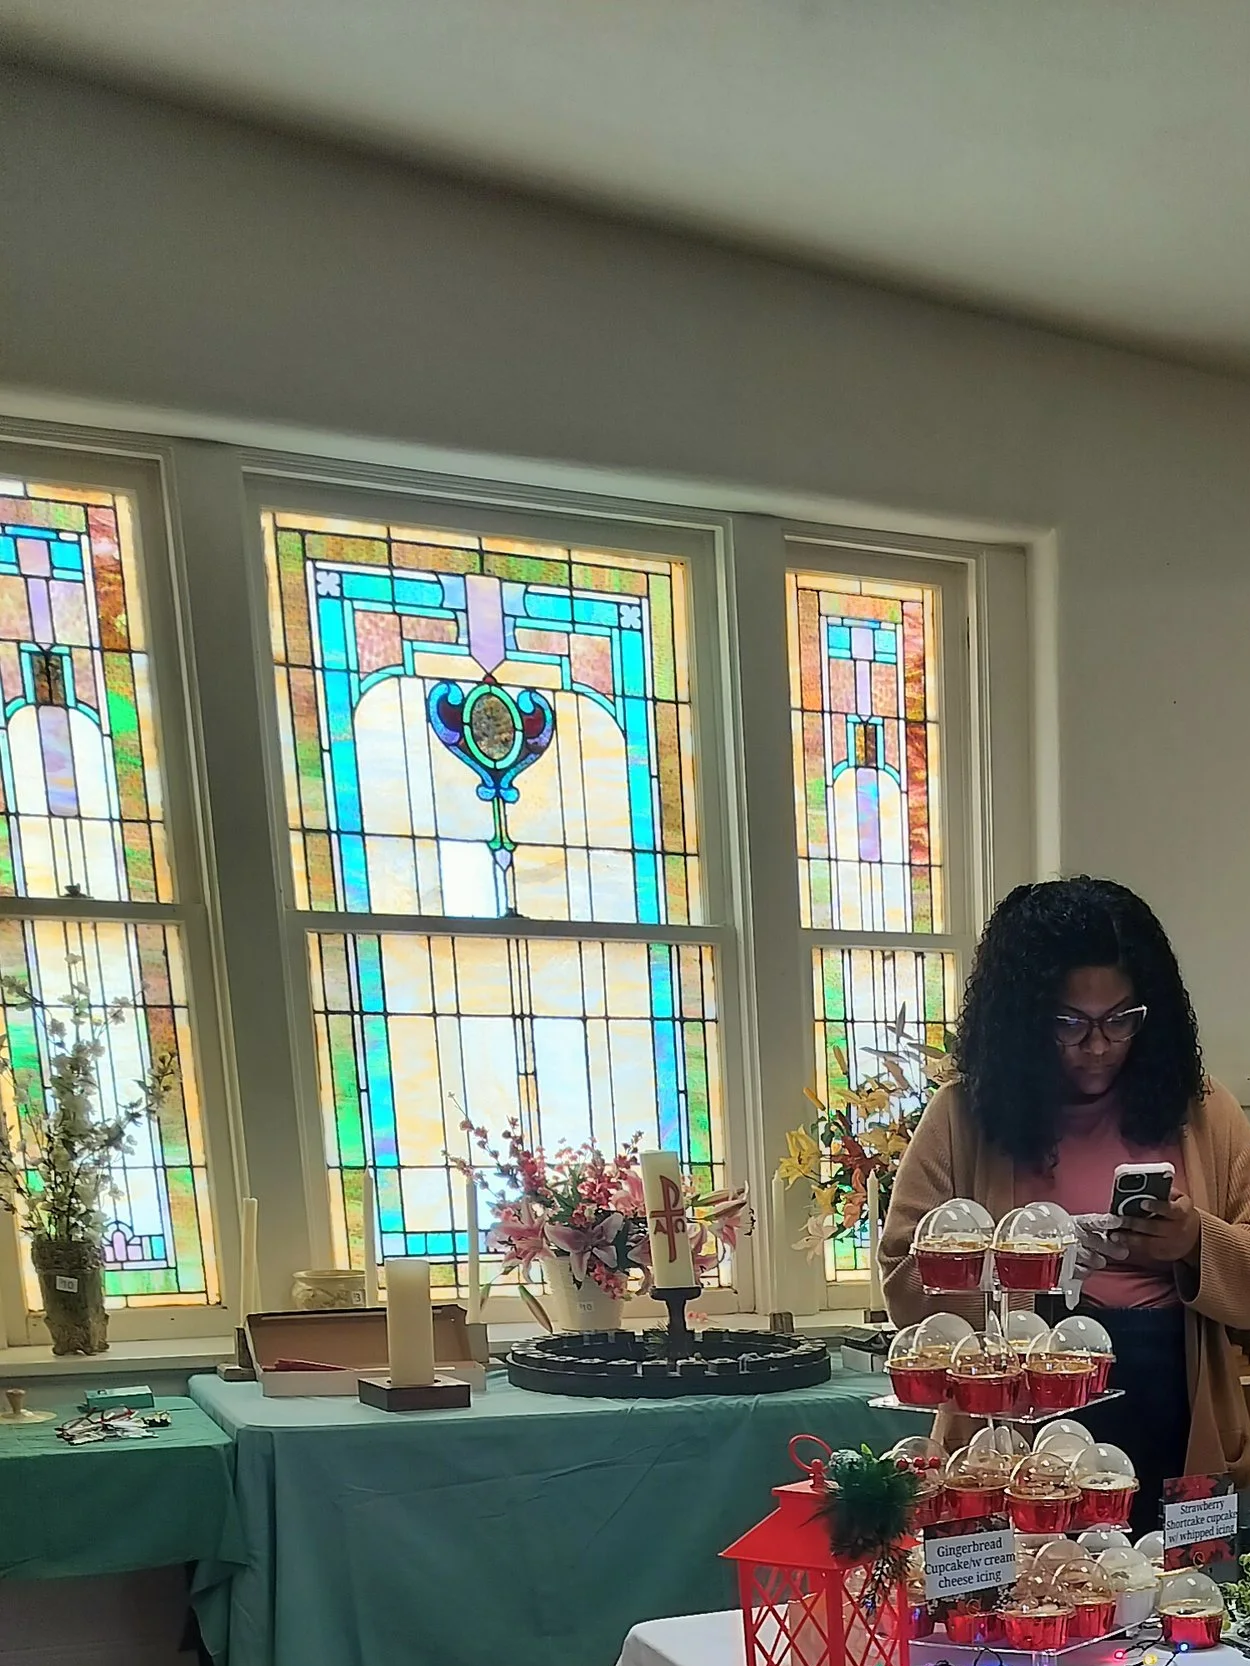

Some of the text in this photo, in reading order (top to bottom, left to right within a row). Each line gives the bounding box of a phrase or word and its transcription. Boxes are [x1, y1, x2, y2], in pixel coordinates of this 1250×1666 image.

[1180, 1500, 1224, 1515] Strawberry
[1166, 1509, 1238, 1531] Shortcake cupcake
[1168, 1523, 1235, 1543] w/ whipped icing
[936, 1537, 1003, 1558] Gingerbread
[924, 1552, 1016, 1576] Cupcake/w cream
[938, 1570, 1002, 1589] cheese icing
